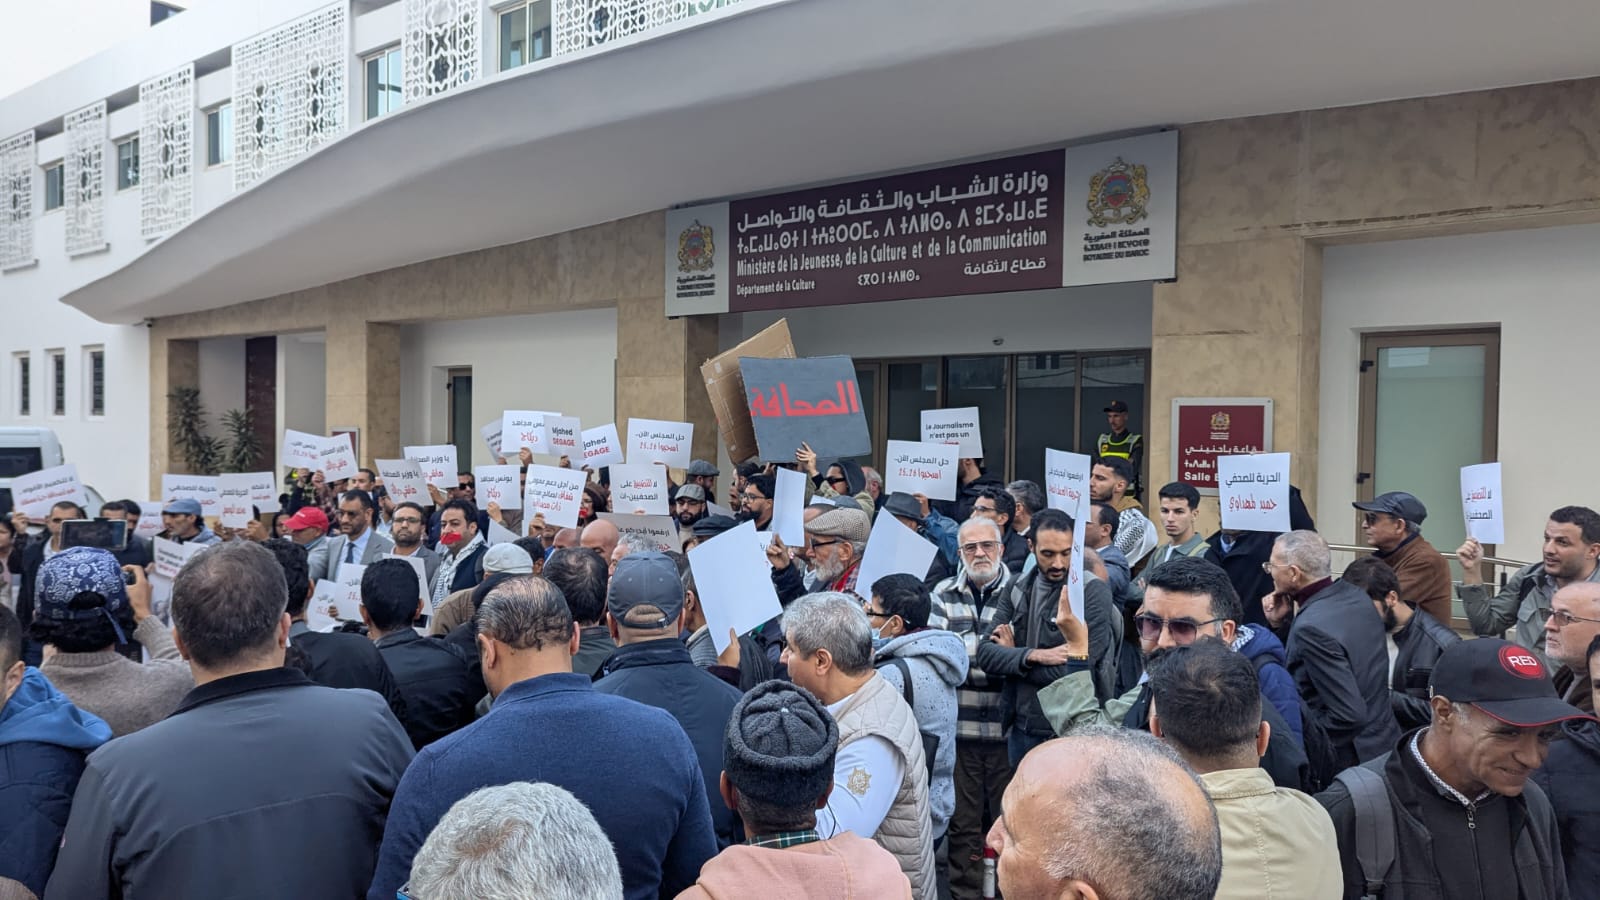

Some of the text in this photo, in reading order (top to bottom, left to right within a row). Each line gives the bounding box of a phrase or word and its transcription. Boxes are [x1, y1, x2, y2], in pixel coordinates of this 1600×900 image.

[737, 170, 1048, 233] وزارة الشباب والثقافة والتواصل
[737, 226, 1047, 276] Ministère de la Jeunesse, de la Culture et de la Communication
[964, 257, 1046, 275] قطاع الثقافة
[737, 278, 815, 297] Département de la Culture
[749, 380, 859, 417] الصحافة
[933, 421, 974, 430] Journalisme
[946, 432, 959, 440] pas
[583, 436, 607, 450] jahed
[583, 446, 610, 458] EGAGE
[910, 455, 937, 465] المجلس
[1184, 472, 1210, 482] Salle
[1225, 472, 1255, 488] للصحفي
[1256, 472, 1281, 485] الحرية
[1507, 655, 1538, 667] RED
